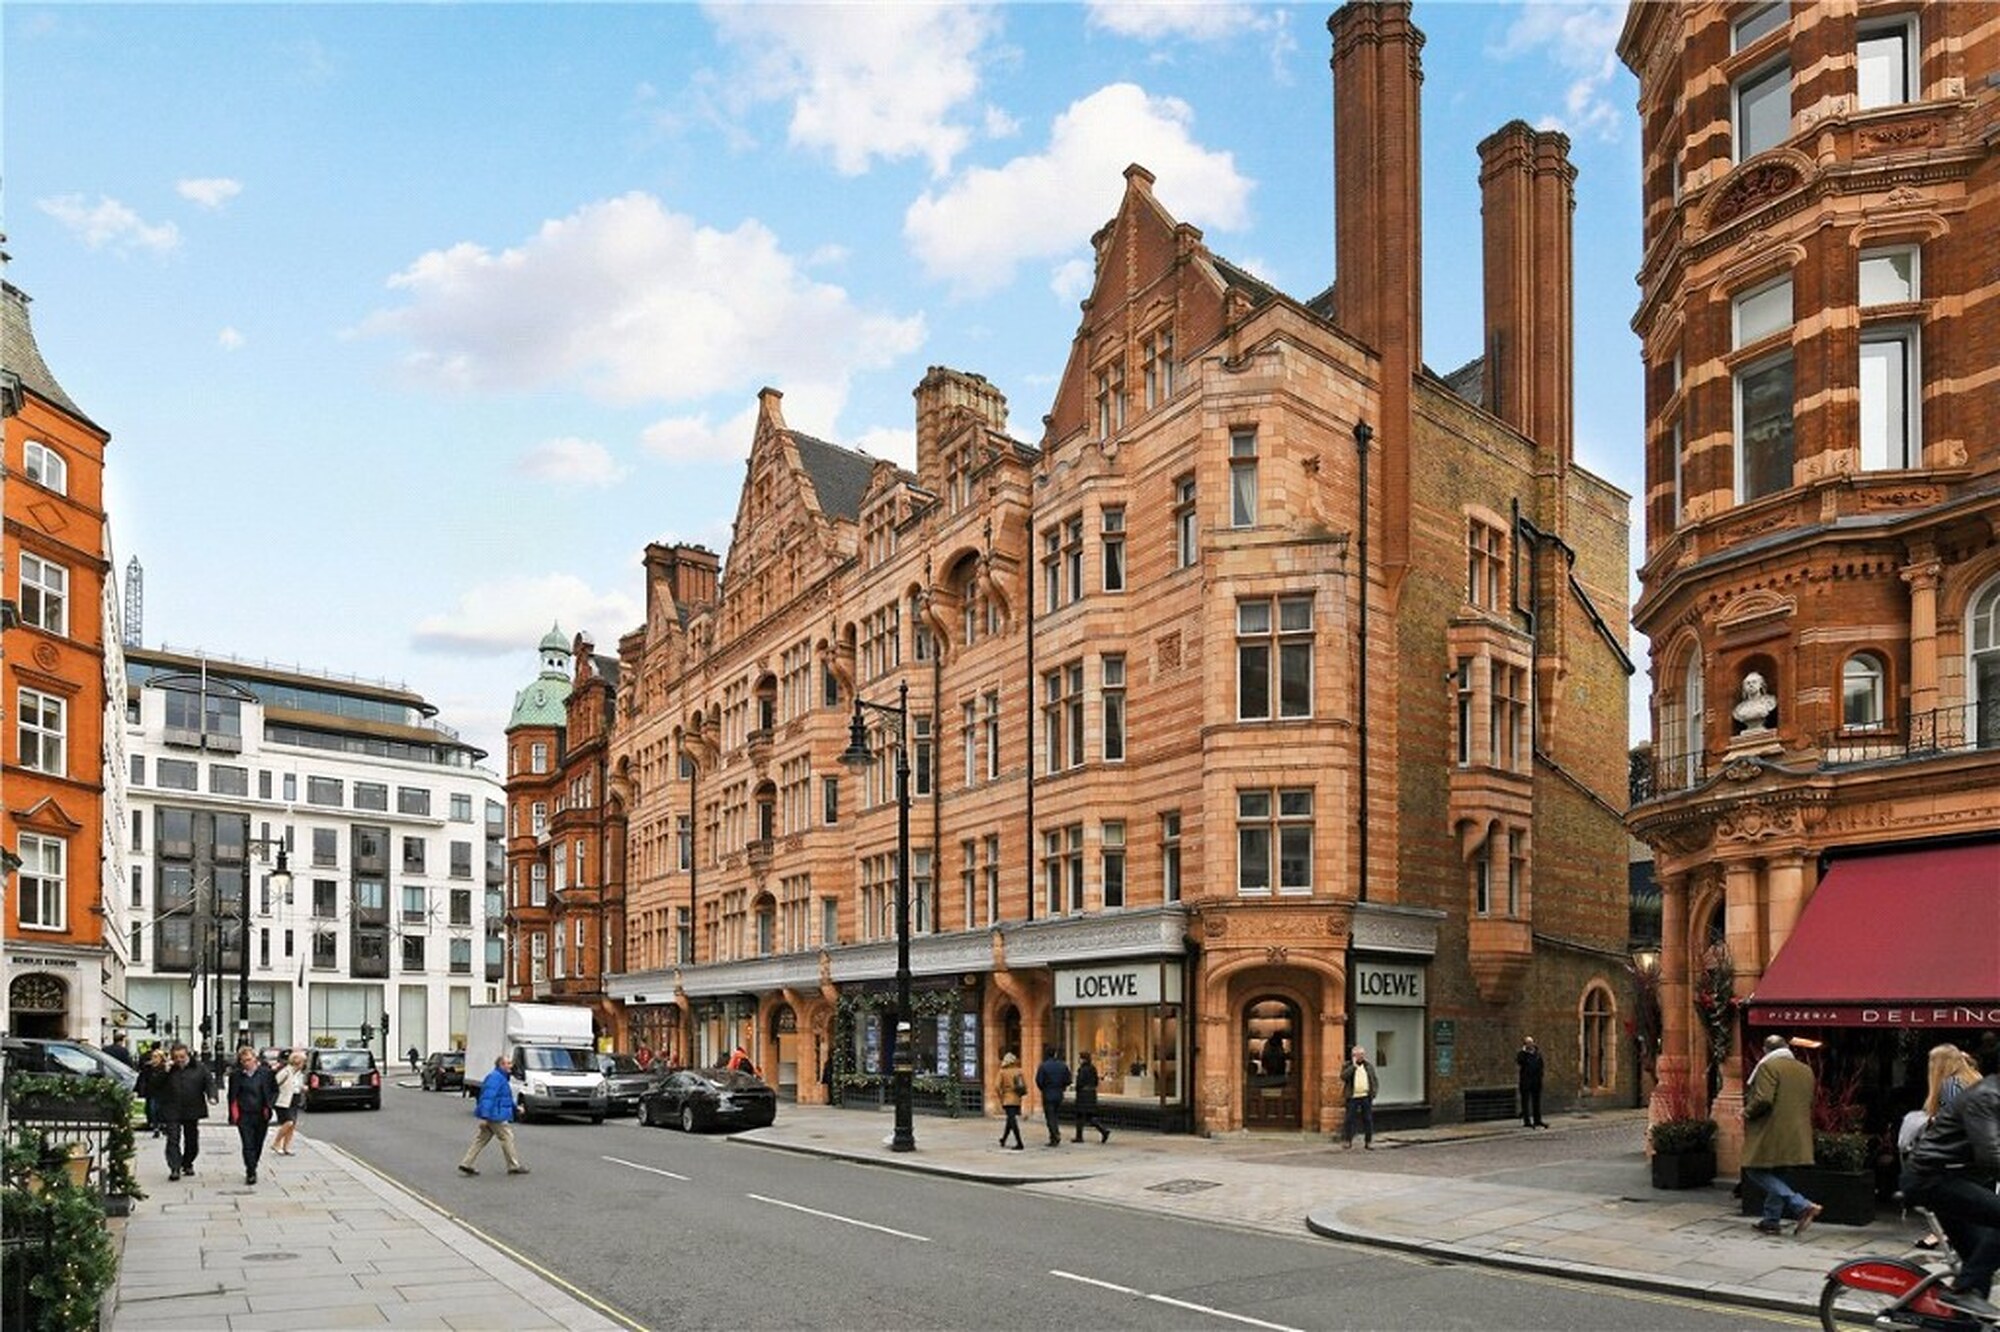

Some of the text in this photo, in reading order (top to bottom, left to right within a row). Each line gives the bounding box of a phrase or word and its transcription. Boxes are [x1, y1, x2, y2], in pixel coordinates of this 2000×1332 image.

[1076, 973, 1137, 998] LOEWE
[1360, 972, 1418, 996] LOEWE
[1768, 1006, 2000, 1022] PIZZERIA DELFINO
